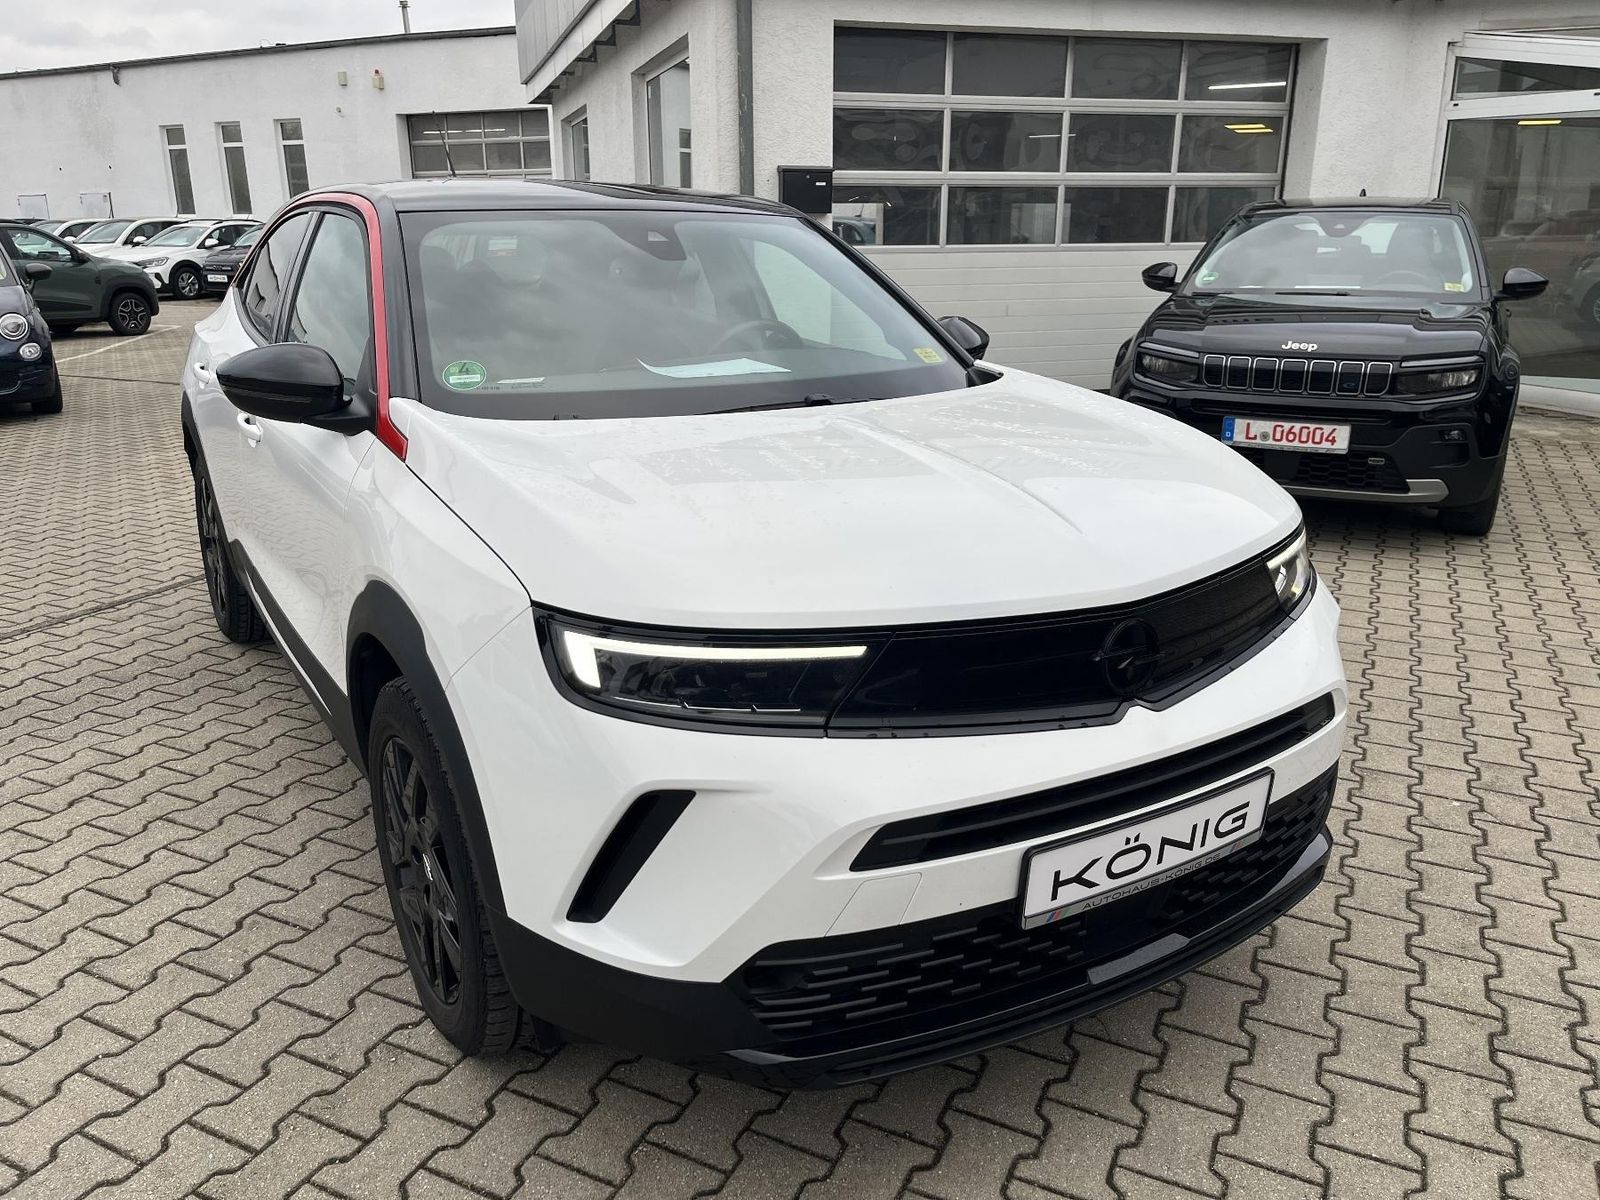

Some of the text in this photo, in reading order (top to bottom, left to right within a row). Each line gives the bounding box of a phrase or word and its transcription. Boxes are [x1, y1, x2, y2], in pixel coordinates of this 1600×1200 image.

[1281, 340, 1318, 352] Jeep
[458, 362, 471, 375] 4
[1245, 423, 1337, 446] L 06004
[1050, 800, 1251, 902] KÖNIG
